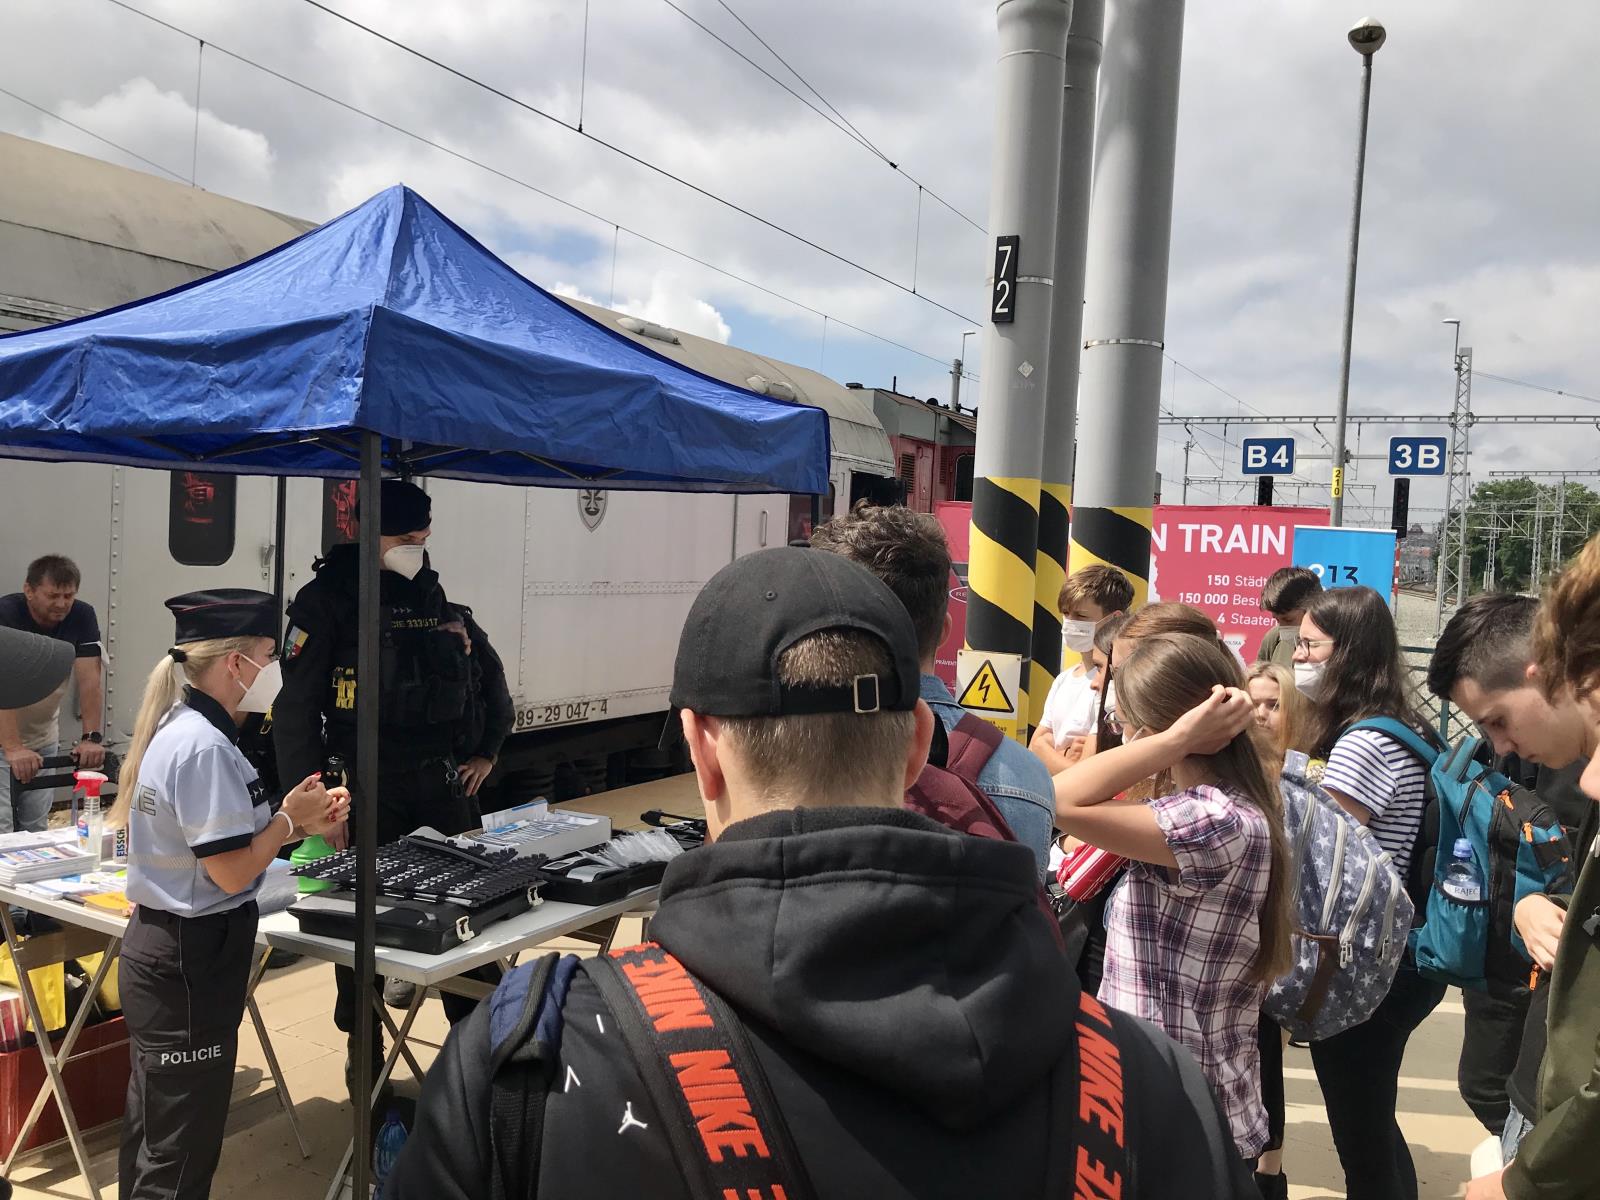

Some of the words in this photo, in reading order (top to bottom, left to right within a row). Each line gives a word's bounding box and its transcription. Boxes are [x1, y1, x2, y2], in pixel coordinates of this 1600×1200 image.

[995, 246, 1011, 313] 72
[1178, 523, 1286, 556] TRAIN
[1207, 574, 1230, 586] 150
[1178, 592, 1201, 604] 150
[1204, 593, 1229, 605] 000
[1217, 612, 1226, 624] 4
[1231, 613, 1278, 626] Staaten
[622, 952, 714, 1033] NIKE
[160, 1044, 222, 1066] POLICIE
[1074, 1022, 1124, 1148] NIKE
[669, 1049, 770, 1163] NIKE
